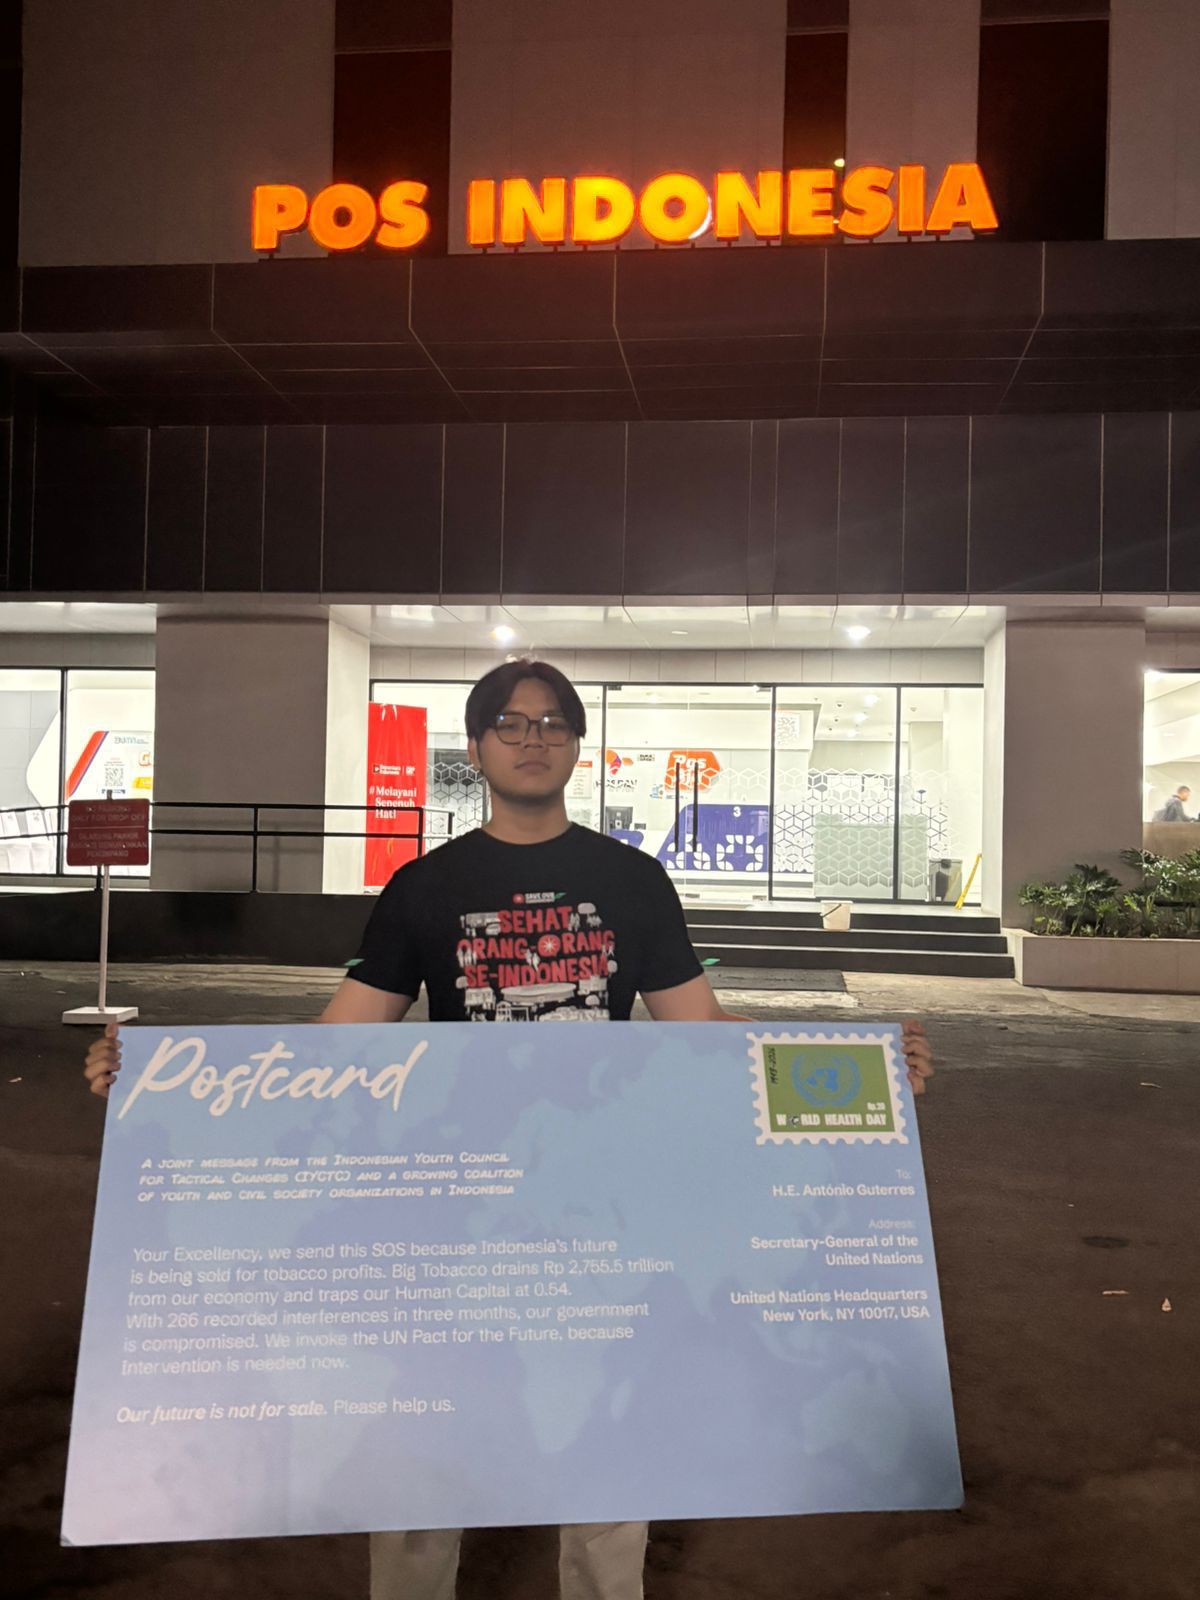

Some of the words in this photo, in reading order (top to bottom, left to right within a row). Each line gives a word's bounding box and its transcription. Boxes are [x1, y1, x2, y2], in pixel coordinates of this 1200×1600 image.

[251, 181, 430, 252] POS
[467, 162, 999, 247] INDONESIA
[733, 806, 742, 817] 3
[497, 906, 573, 934] SEHAT
[464, 953, 609, 988] SE-INDONESIA
[117, 1036, 428, 1120] Postcard
[825, 1114, 862, 1125] HEALTH
[866, 1114, 886, 1125] DAY
[141, 1158, 152, 1169] A
[158, 1159, 194, 1169] JOINT
[200, 1158, 258, 1168] MESSAGE
[264, 1157, 299, 1167] FROM
[306, 1156, 327, 1166] THE
[334, 1155, 408, 1165] INDONESIAN
[415, 1153, 454, 1164] YOUTH
[459, 1152, 510, 1163] COUNCIL
[139, 1175, 164, 1185] FOR
[172, 1174, 225, 1184] TACTICAL
[232, 1173, 288, 1183] CHANGES
[357, 1171, 382, 1181] AND
[388, 1171, 396, 1180] A
[403, 1170, 458, 1180] GROWING
[464, 1169, 524, 1179] COALITION
[138, 1192, 154, 1202] OF
[160, 1191, 200, 1201] YOUTH
[208, 1191, 232, 1200] AND
[239, 1190, 267, 1200] CIVIL
[273, 1189, 323, 1199] SOCIETY
[329, 1187, 424, 1198] ORGANIZATIONS
[430, 1187, 442, 1196] IN
[448, 1184, 514, 1195] INDONESIA
[772, 1185, 800, 1196] H.E.
[857, 1185, 915, 1195] Guterres
[133, 1249, 168, 1262] Your
[174, 1246, 263, 1263] Excellency,
[267, 1248, 291, 1260] we
[296, 1245, 334, 1259] send
[340, 1244, 367, 1258] this
[371, 1243, 405, 1257] SOS
[411, 1242, 476, 1256] because
[481, 1239, 567, 1255] Indonesia's
[572, 1238, 617, 1253] future
[751, 1236, 877, 1250] Secretary-General
[881, 1236, 894, 1247] of
[898, 1235, 919, 1246] the
[826, 1254, 869, 1265] United
[873, 1253, 924, 1264] Nations
[130, 1270, 143, 1284] is
[148, 1269, 192, 1286] being
[197, 1268, 230, 1283] sold
[236, 1267, 258, 1282] for
[264, 1266, 327, 1281] tobacco
[331, 1264, 386, 1282] profits.
[392, 1264, 416, 1281] Big
[421, 1263, 487, 1278] Tobacco
[491, 1261, 538, 1276] drains
[544, 1261, 564, 1278] Rp
[569, 1259, 623, 1276] 2,755.5
[628, 1258, 674, 1273] trillion
[128, 1292, 166, 1306] from
[171, 1293, 199, 1305] our
[204, 1290, 279, 1309] economy
[283, 1288, 313, 1302] and
[318, 1287, 358, 1305] traps
[363, 1287, 389, 1301] our
[395, 1285, 451, 1300] Human
[456, 1283, 510, 1301] Capital
[515, 1283, 529, 1296] at
[534, 1282, 572, 1297] 0.54.
[730, 1292, 775, 1304] United
[779, 1290, 830, 1303] Nations
[834, 1289, 928, 1303] Headquarters
[126, 1314, 162, 1328] With
[167, 1312, 199, 1327] 266
[204, 1311, 277, 1327] recorded
[283, 1309, 389, 1325] interferences
[393, 1307, 407, 1322] in
[413, 1306, 453, 1321] three
[458, 1305, 521, 1321] months,
[526, 1305, 552, 1319] our
[557, 1302, 649, 1321] government
[763, 1309, 794, 1322] New
[798, 1309, 833, 1323] York,
[837, 1308, 855, 1320] NY
[900, 1306, 929, 1318] USA
[124, 1337, 136, 1351] is
[142, 1334, 259, 1353] compromised.
[264, 1333, 290, 1348] We
[296, 1332, 347, 1347] invoke
[353, 1331, 378, 1345] the
[383, 1330, 408, 1344] UN
[413, 1328, 447, 1343] Pact
[453, 1328, 474, 1342] for
[480, 1327, 504, 1342] the
[509, 1326, 563, 1341] Future,
[568, 1325, 634, 1339] because
[121, 1358, 221, 1376] Intervention
[227, 1357, 239, 1372] is
[245, 1355, 306, 1371] needed
[311, 1355, 350, 1369] now.
[117, 1407, 149, 1423] Our
[151, 1405, 206, 1425] future
[210, 1403, 224, 1419] is
[228, 1402, 256, 1418] not
[259, 1401, 285, 1420] for
[288, 1401, 327, 1416] sale.
[334, 1399, 387, 1414] Please
[392, 1397, 427, 1414] help
[432, 1398, 455, 1412] us.
